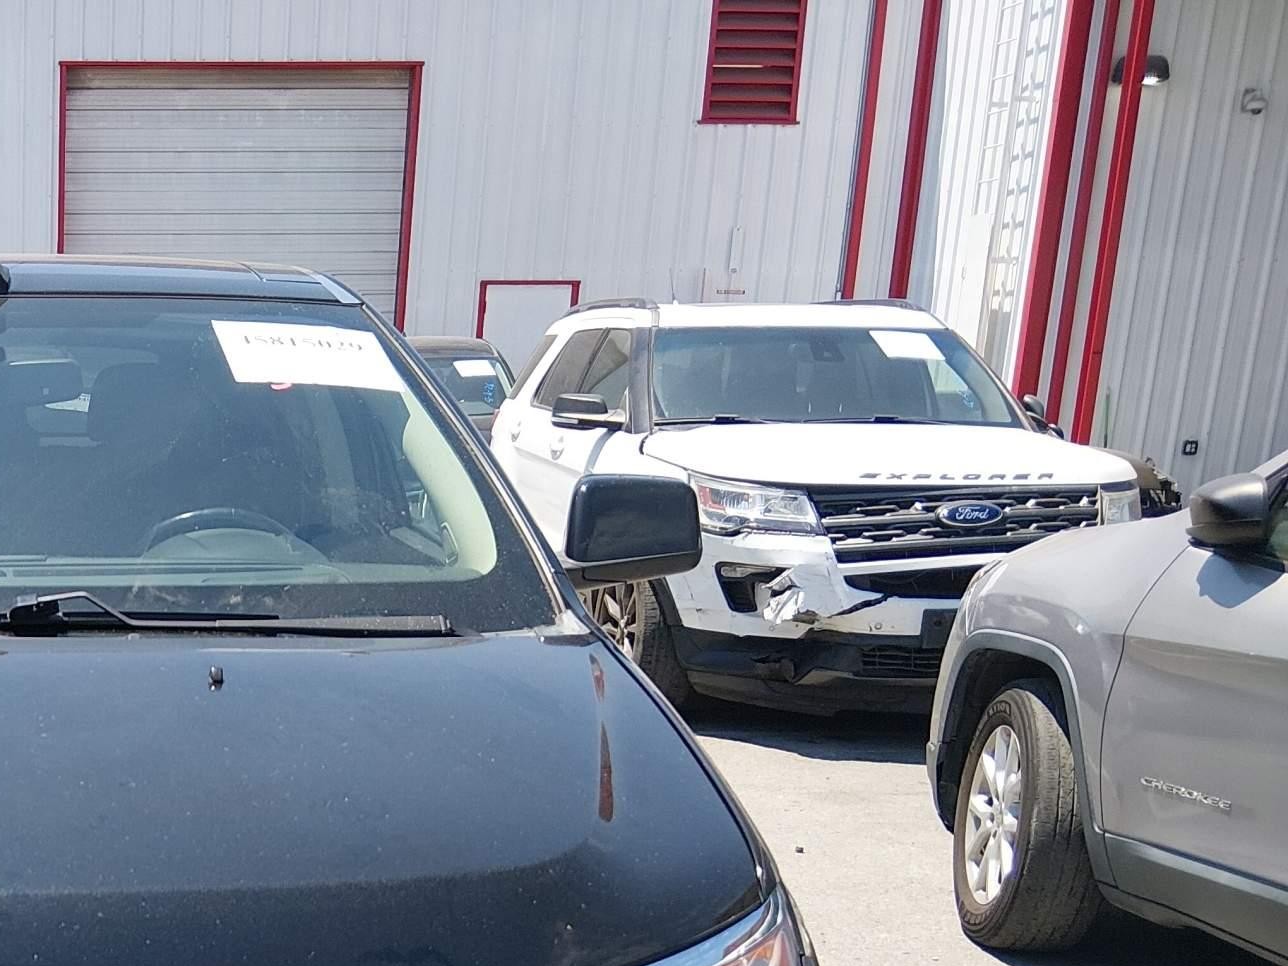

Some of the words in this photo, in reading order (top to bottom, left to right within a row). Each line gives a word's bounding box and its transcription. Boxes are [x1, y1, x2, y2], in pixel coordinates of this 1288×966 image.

[859, 472, 1054, 481] EXPLORER
[955, 506, 990, 521] Ford
[1139, 776, 1233, 810] CHEROKEE
